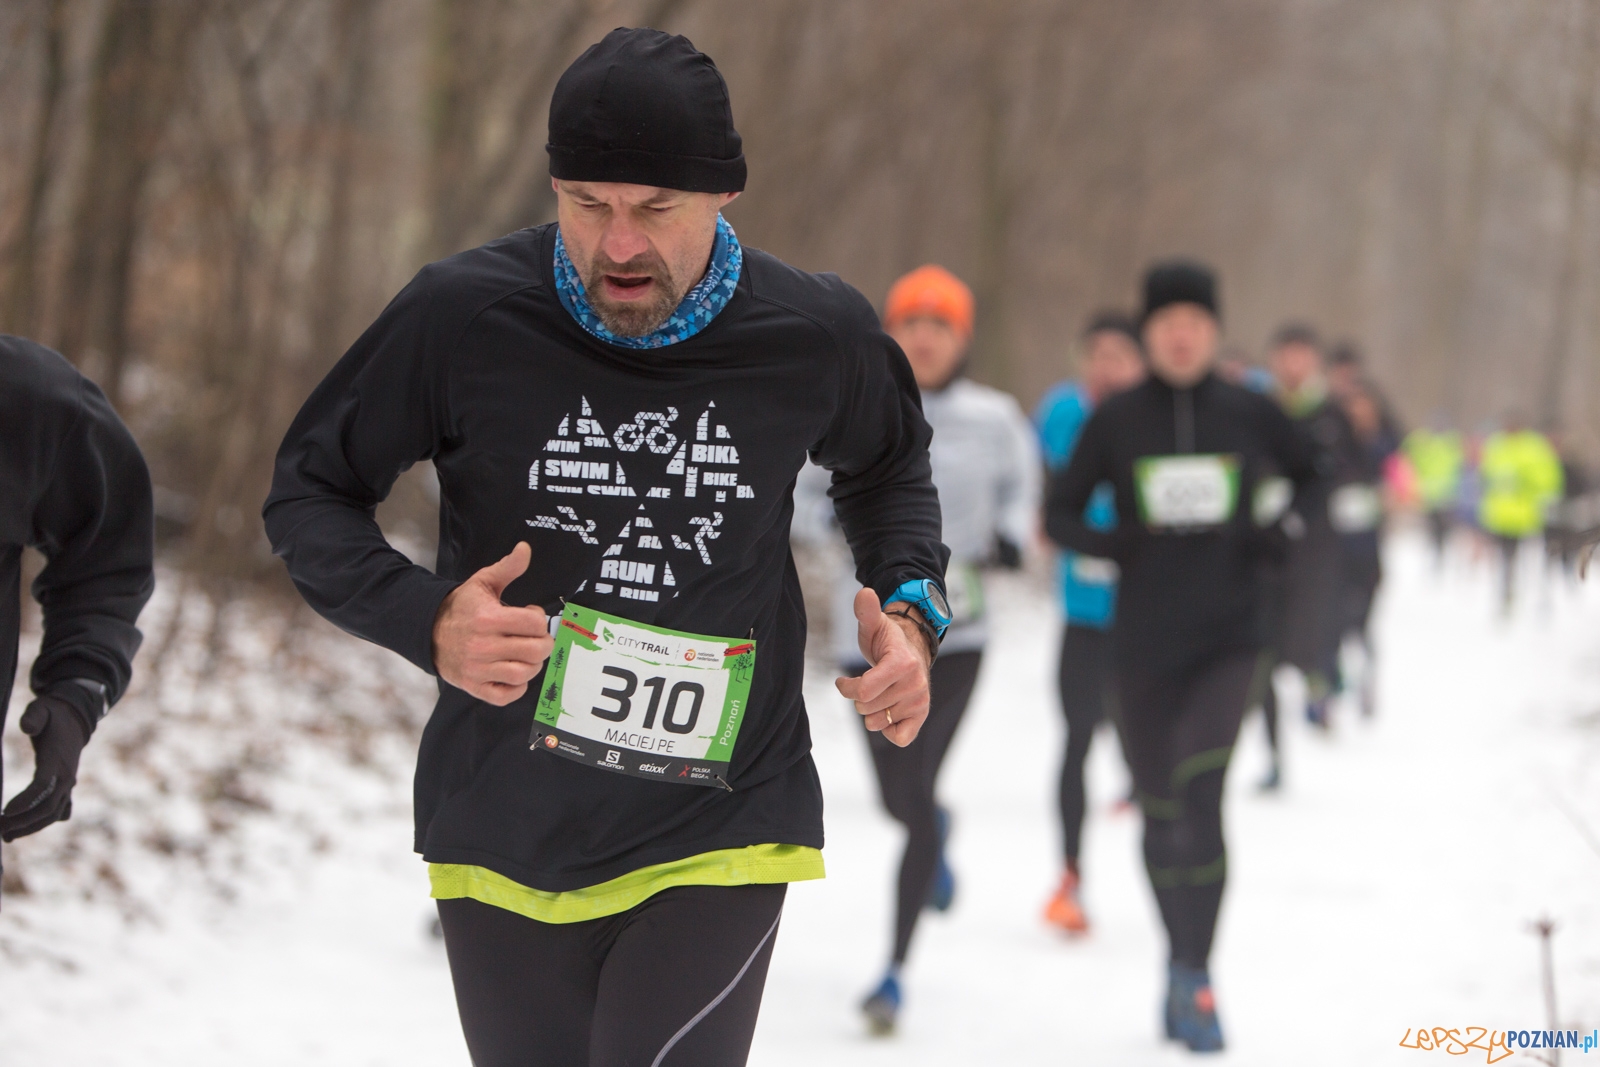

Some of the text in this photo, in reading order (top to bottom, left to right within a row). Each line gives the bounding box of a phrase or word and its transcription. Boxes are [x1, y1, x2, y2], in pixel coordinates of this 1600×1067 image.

[544, 459, 609, 480] SWIM
[703, 472, 738, 486] BIKE
[600, 560, 655, 584] RUN
[590, 665, 705, 735] 310
[719, 699, 741, 746] Poznań
[604, 728, 676, 753] MACIEJ PE
[596, 760, 625, 771] salomon
[691, 766, 711, 774] POLSKA
